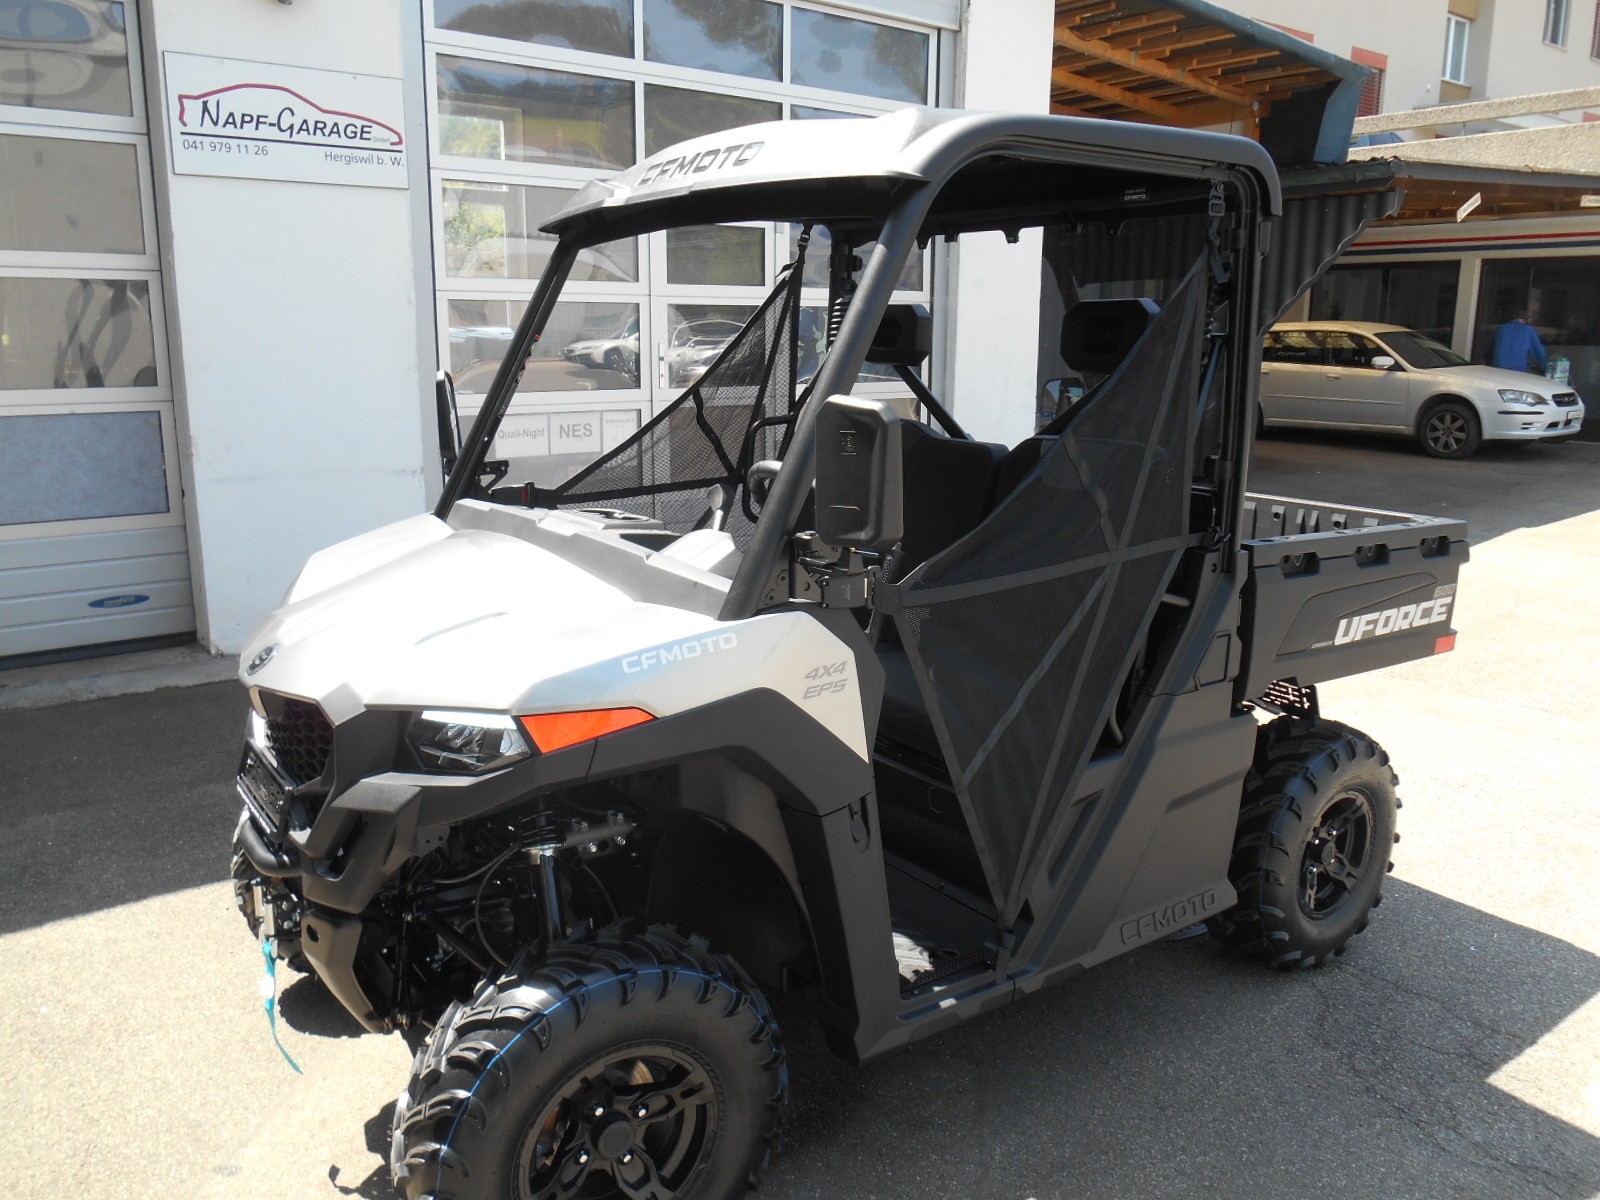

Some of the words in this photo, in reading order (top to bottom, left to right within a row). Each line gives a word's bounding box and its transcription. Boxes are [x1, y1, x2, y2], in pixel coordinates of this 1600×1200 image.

[182, 139, 205, 151] 041
[209, 141, 232, 154] 979
[236, 143, 249, 155] 11
[253, 145, 269, 156] 26
[324, 151, 374, 167] Hergiswil
[376, 154, 388, 166] b.
[390, 156, 405, 167] W.
[637, 141, 765, 187] CFMOTO
[497, 428, 546, 440] Quali-Night
[559, 423, 593, 439] NES
[1334, 596, 1453, 646] UFORCE
[621, 631, 739, 675] CFMOTO
[803, 660, 848, 681] 4X4
[802, 678, 848, 700] EPS
[1120, 888, 1217, 945] CFMOTO
